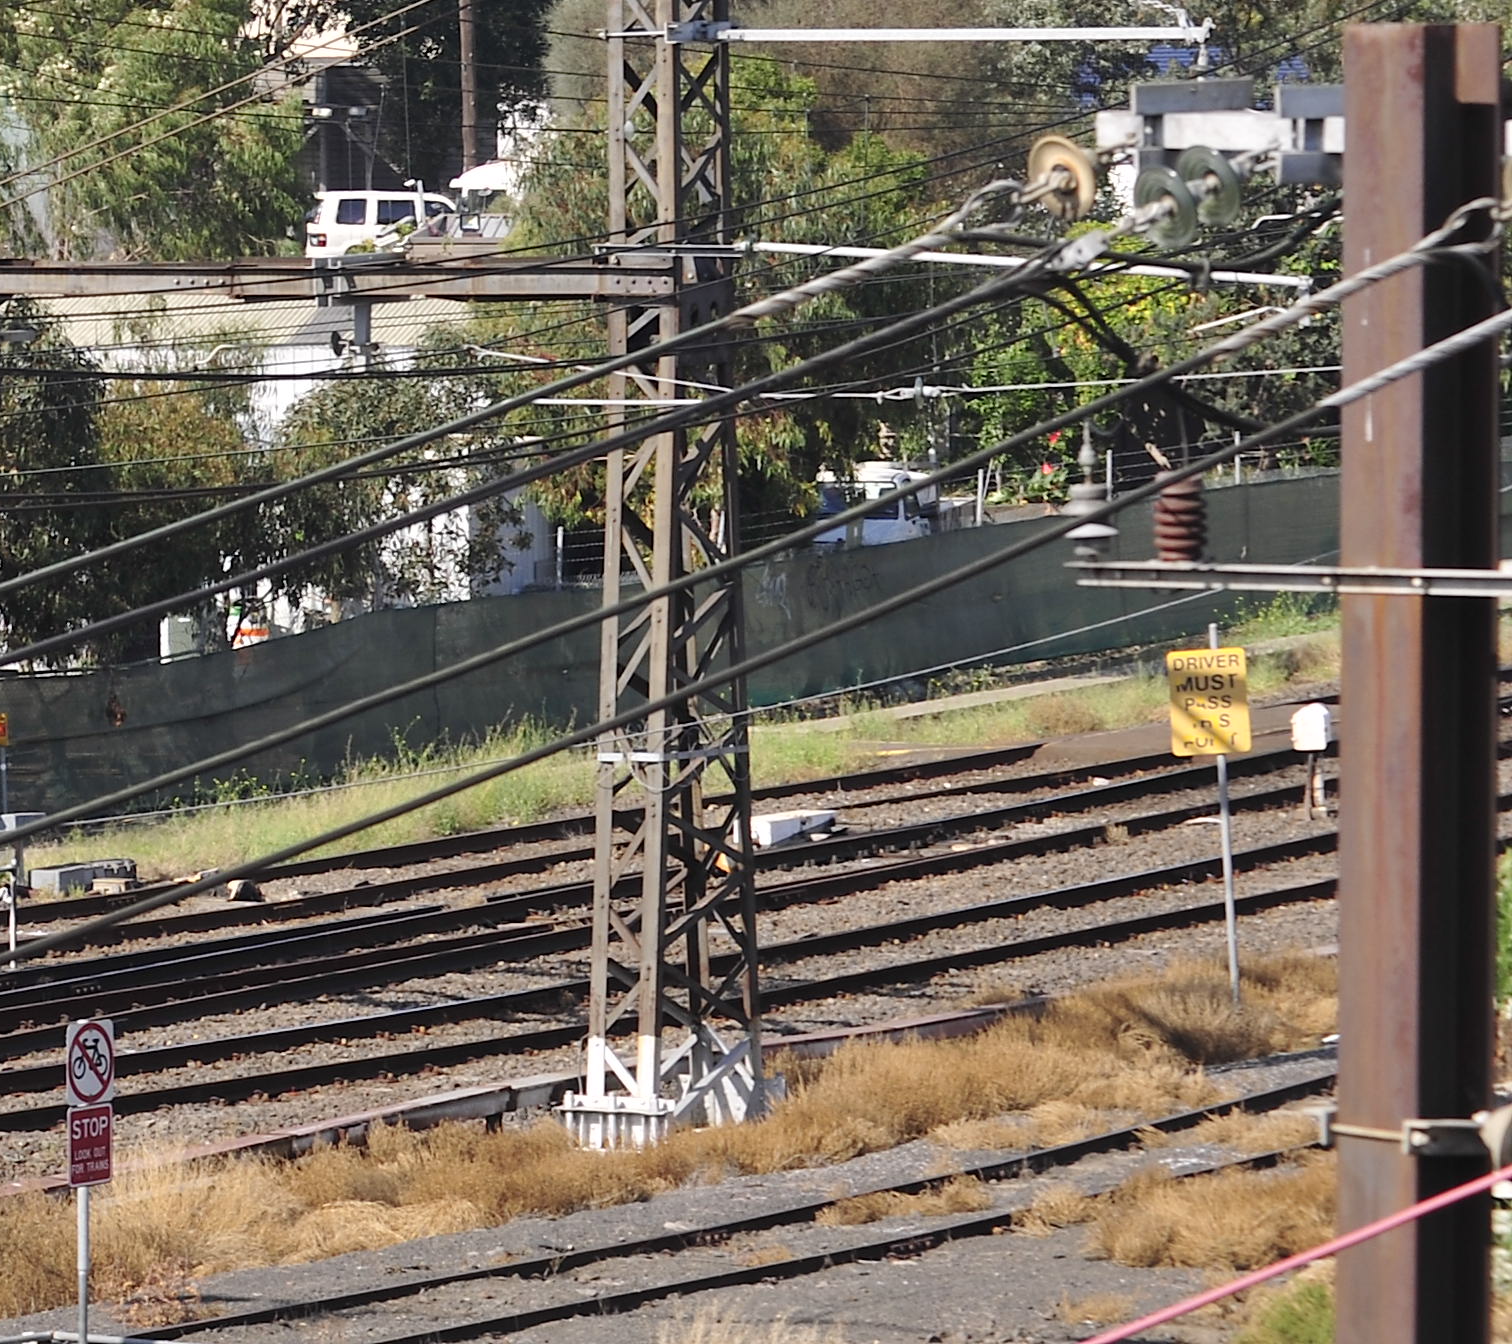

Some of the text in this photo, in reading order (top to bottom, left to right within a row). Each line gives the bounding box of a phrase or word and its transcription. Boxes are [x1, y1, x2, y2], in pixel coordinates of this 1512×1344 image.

[1173, 654, 1240, 672] DRIVER
[1176, 673, 1238, 693] MUST
[72, 1115, 109, 1140] STOP
[74, 1145, 106, 1161] LOOK OUT
[72, 1159, 109, 1175] FOR TRAINS
